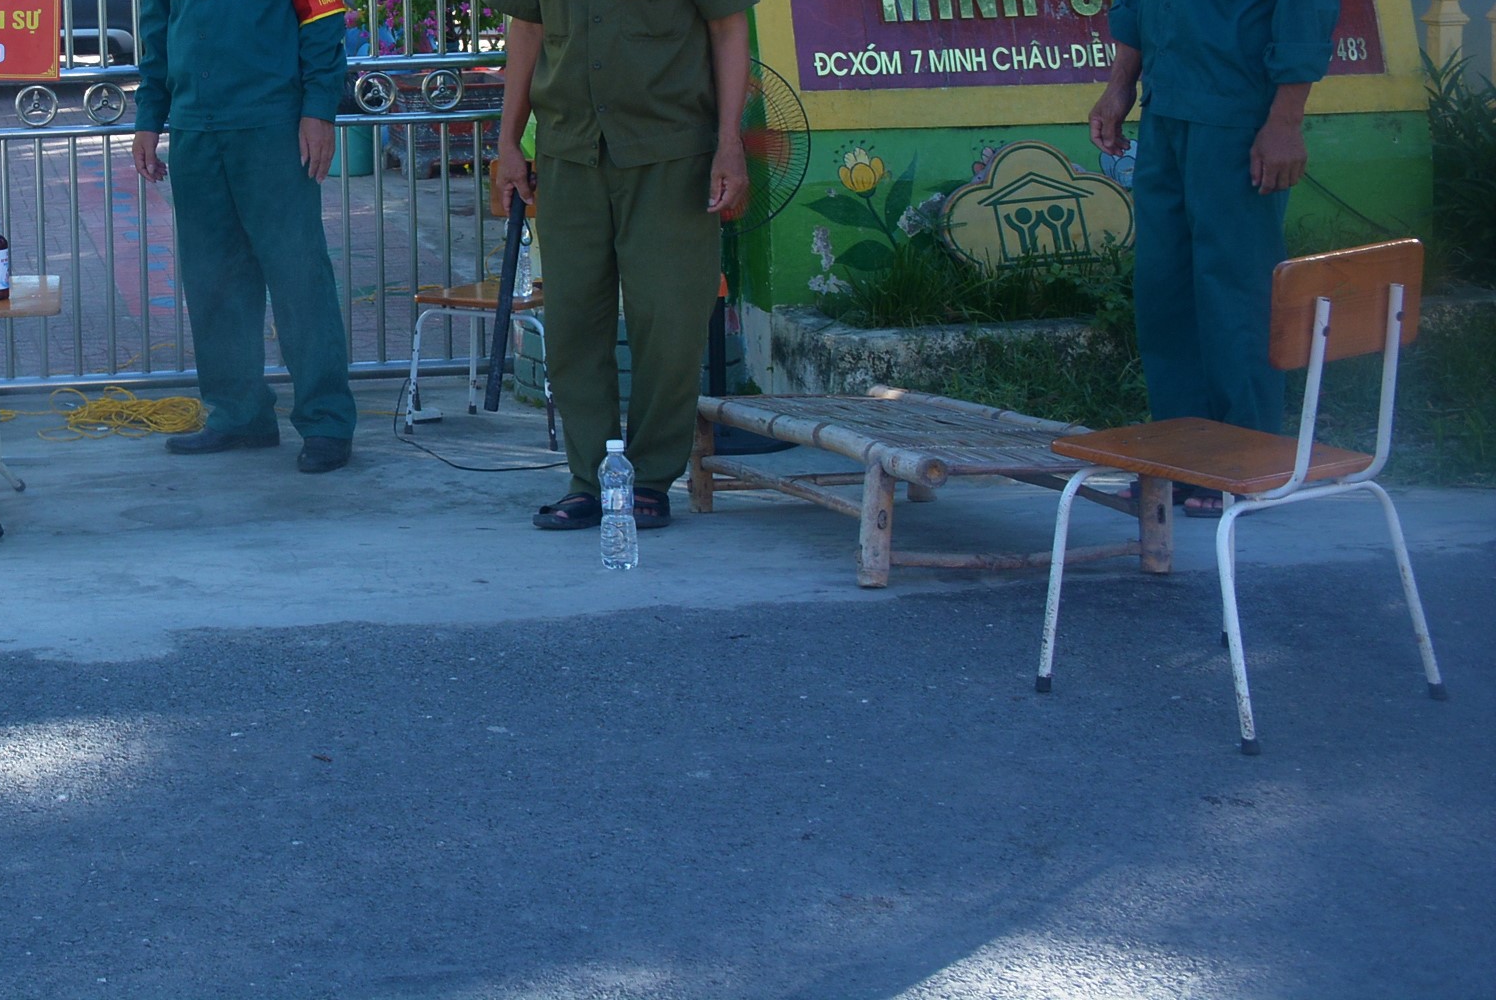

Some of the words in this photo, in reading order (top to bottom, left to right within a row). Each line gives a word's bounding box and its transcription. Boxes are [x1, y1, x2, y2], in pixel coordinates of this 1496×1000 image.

[12, 8, 41, 34] SỰ
[911, 49, 922, 73] 7
[929, 47, 987, 73] MINH
